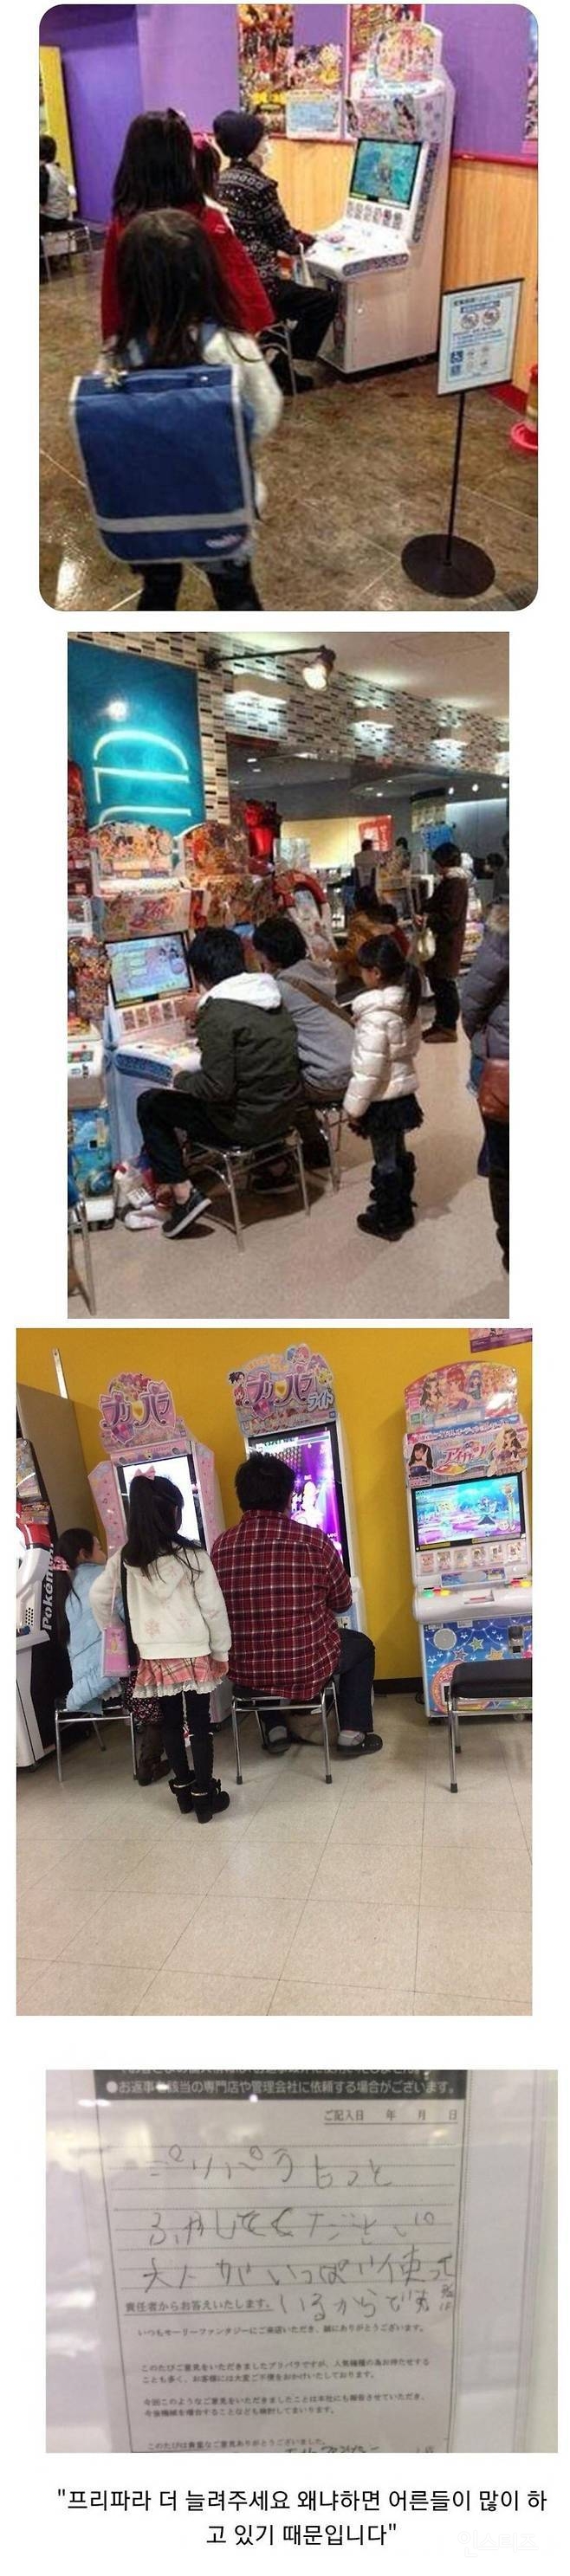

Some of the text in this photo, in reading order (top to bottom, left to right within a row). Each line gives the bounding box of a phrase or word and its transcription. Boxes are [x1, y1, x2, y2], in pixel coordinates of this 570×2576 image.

[308, 1391, 334, 1411] ライト
[118, 2080, 454, 2095] お返事該当の専門店や管理会社に依頼する場合がございます。
[324, 2109, 457, 2121] ご記入日 年 月 日
[125, 2298, 271, 2313] 責任者からお答えいたします。
